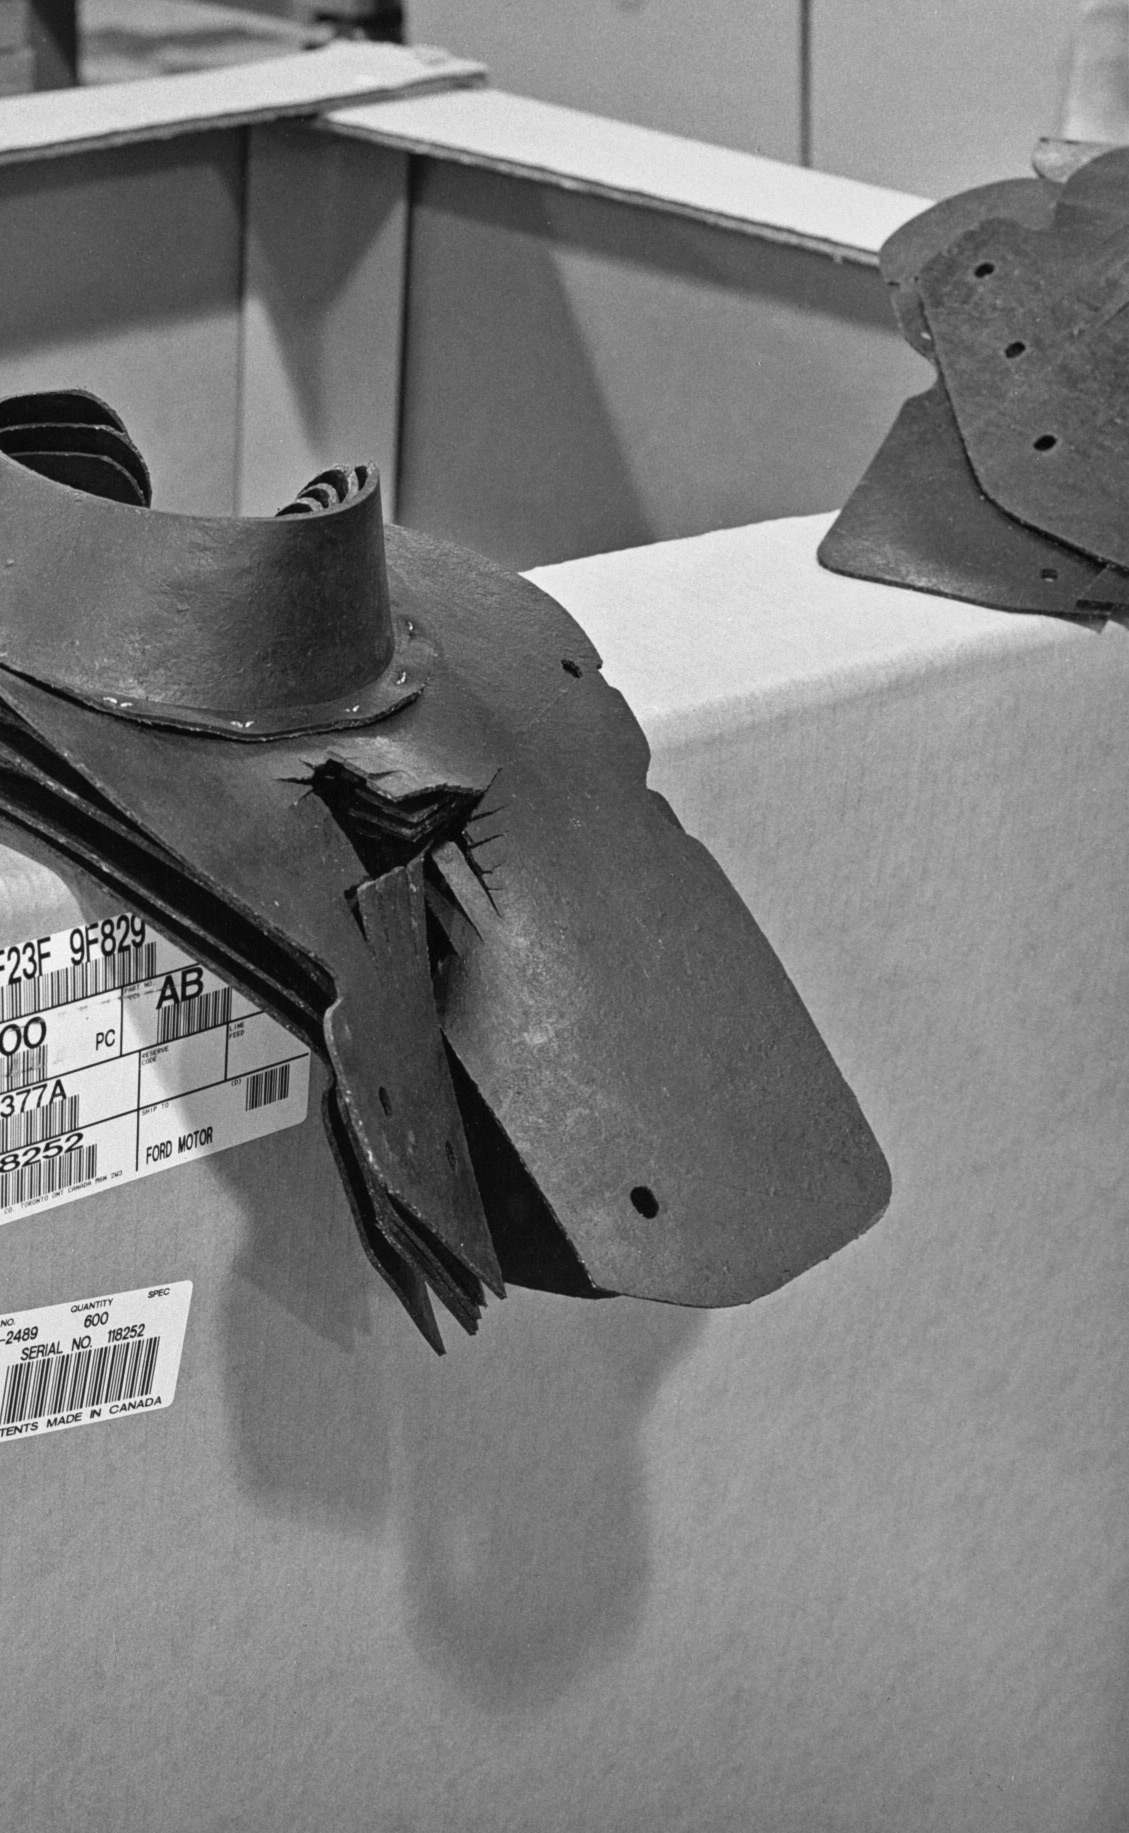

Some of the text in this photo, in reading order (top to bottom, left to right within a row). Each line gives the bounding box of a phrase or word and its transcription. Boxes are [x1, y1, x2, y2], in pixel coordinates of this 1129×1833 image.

[69, 914, 146, 966] 9F829
[156, 966, 204, 1009] AB
[229, 1021, 245, 1032] LINE
[229, 1030, 245, 1039] FEED
[95, 1029, 116, 1051] PC
[141, 1046, 169, 1059] RESERVE
[141, 1057, 157, 1066] CODE
[141, 1106, 158, 1116] SHIP
[145, 1126, 213, 1165] FORD MOTOR
[20, 1195, 49, 1209] TORONTO
[52, 1189, 64, 1199] ONT
[68, 1180, 91, 1193] CANADA
[147, 1287, 171, 1299] SPEC
[70, 1298, 114, 1313] QUANTITY
[0, 1317, 15, 1328] NO.
[83, 1311, 109, 1328] 600
[20, 1323, 145, 1361] SERIAL NO. 118252
[46, 1412, 83, 1428] MADE
[89, 1407, 102, 1419] IN
[108, 1395, 162, 1415] CANADA
